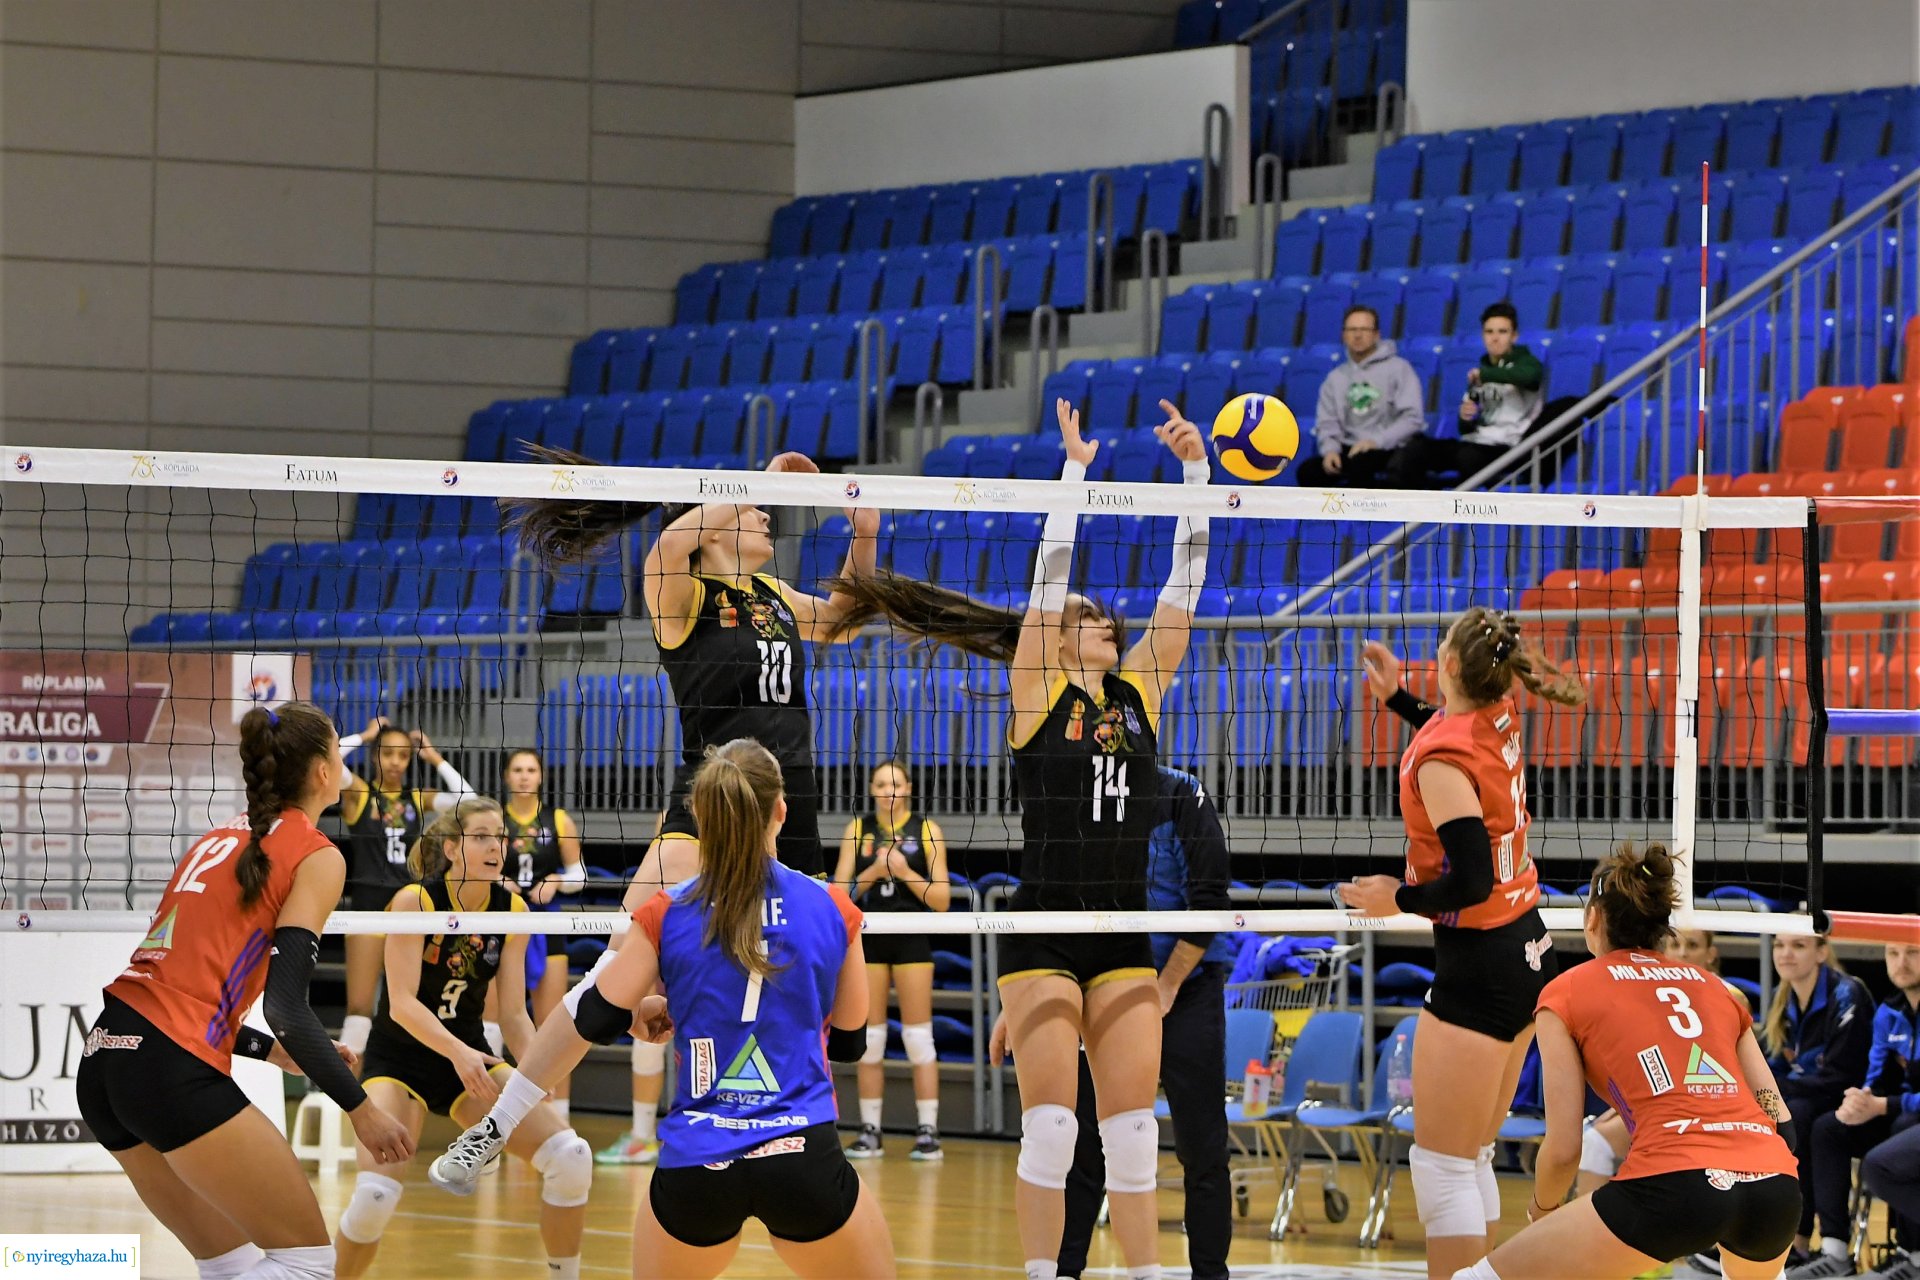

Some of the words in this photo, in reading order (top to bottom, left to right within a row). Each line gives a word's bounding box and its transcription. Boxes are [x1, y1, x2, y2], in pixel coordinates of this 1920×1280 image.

[756, 640, 792, 704] 10
[1092, 755, 1130, 822] 14
[173, 836, 239, 893] 12
[1607, 965, 1706, 983] MILANOVA
[437, 979, 468, 1020] 9
[1655, 986, 1703, 1039] 3
[1645, 1050, 1667, 1091] STRABAG
[1687, 1084, 1725, 1094] KE-VIZ
[1726, 1084, 1739, 1094] 21
[713, 1115, 809, 1131] BESTRONG
